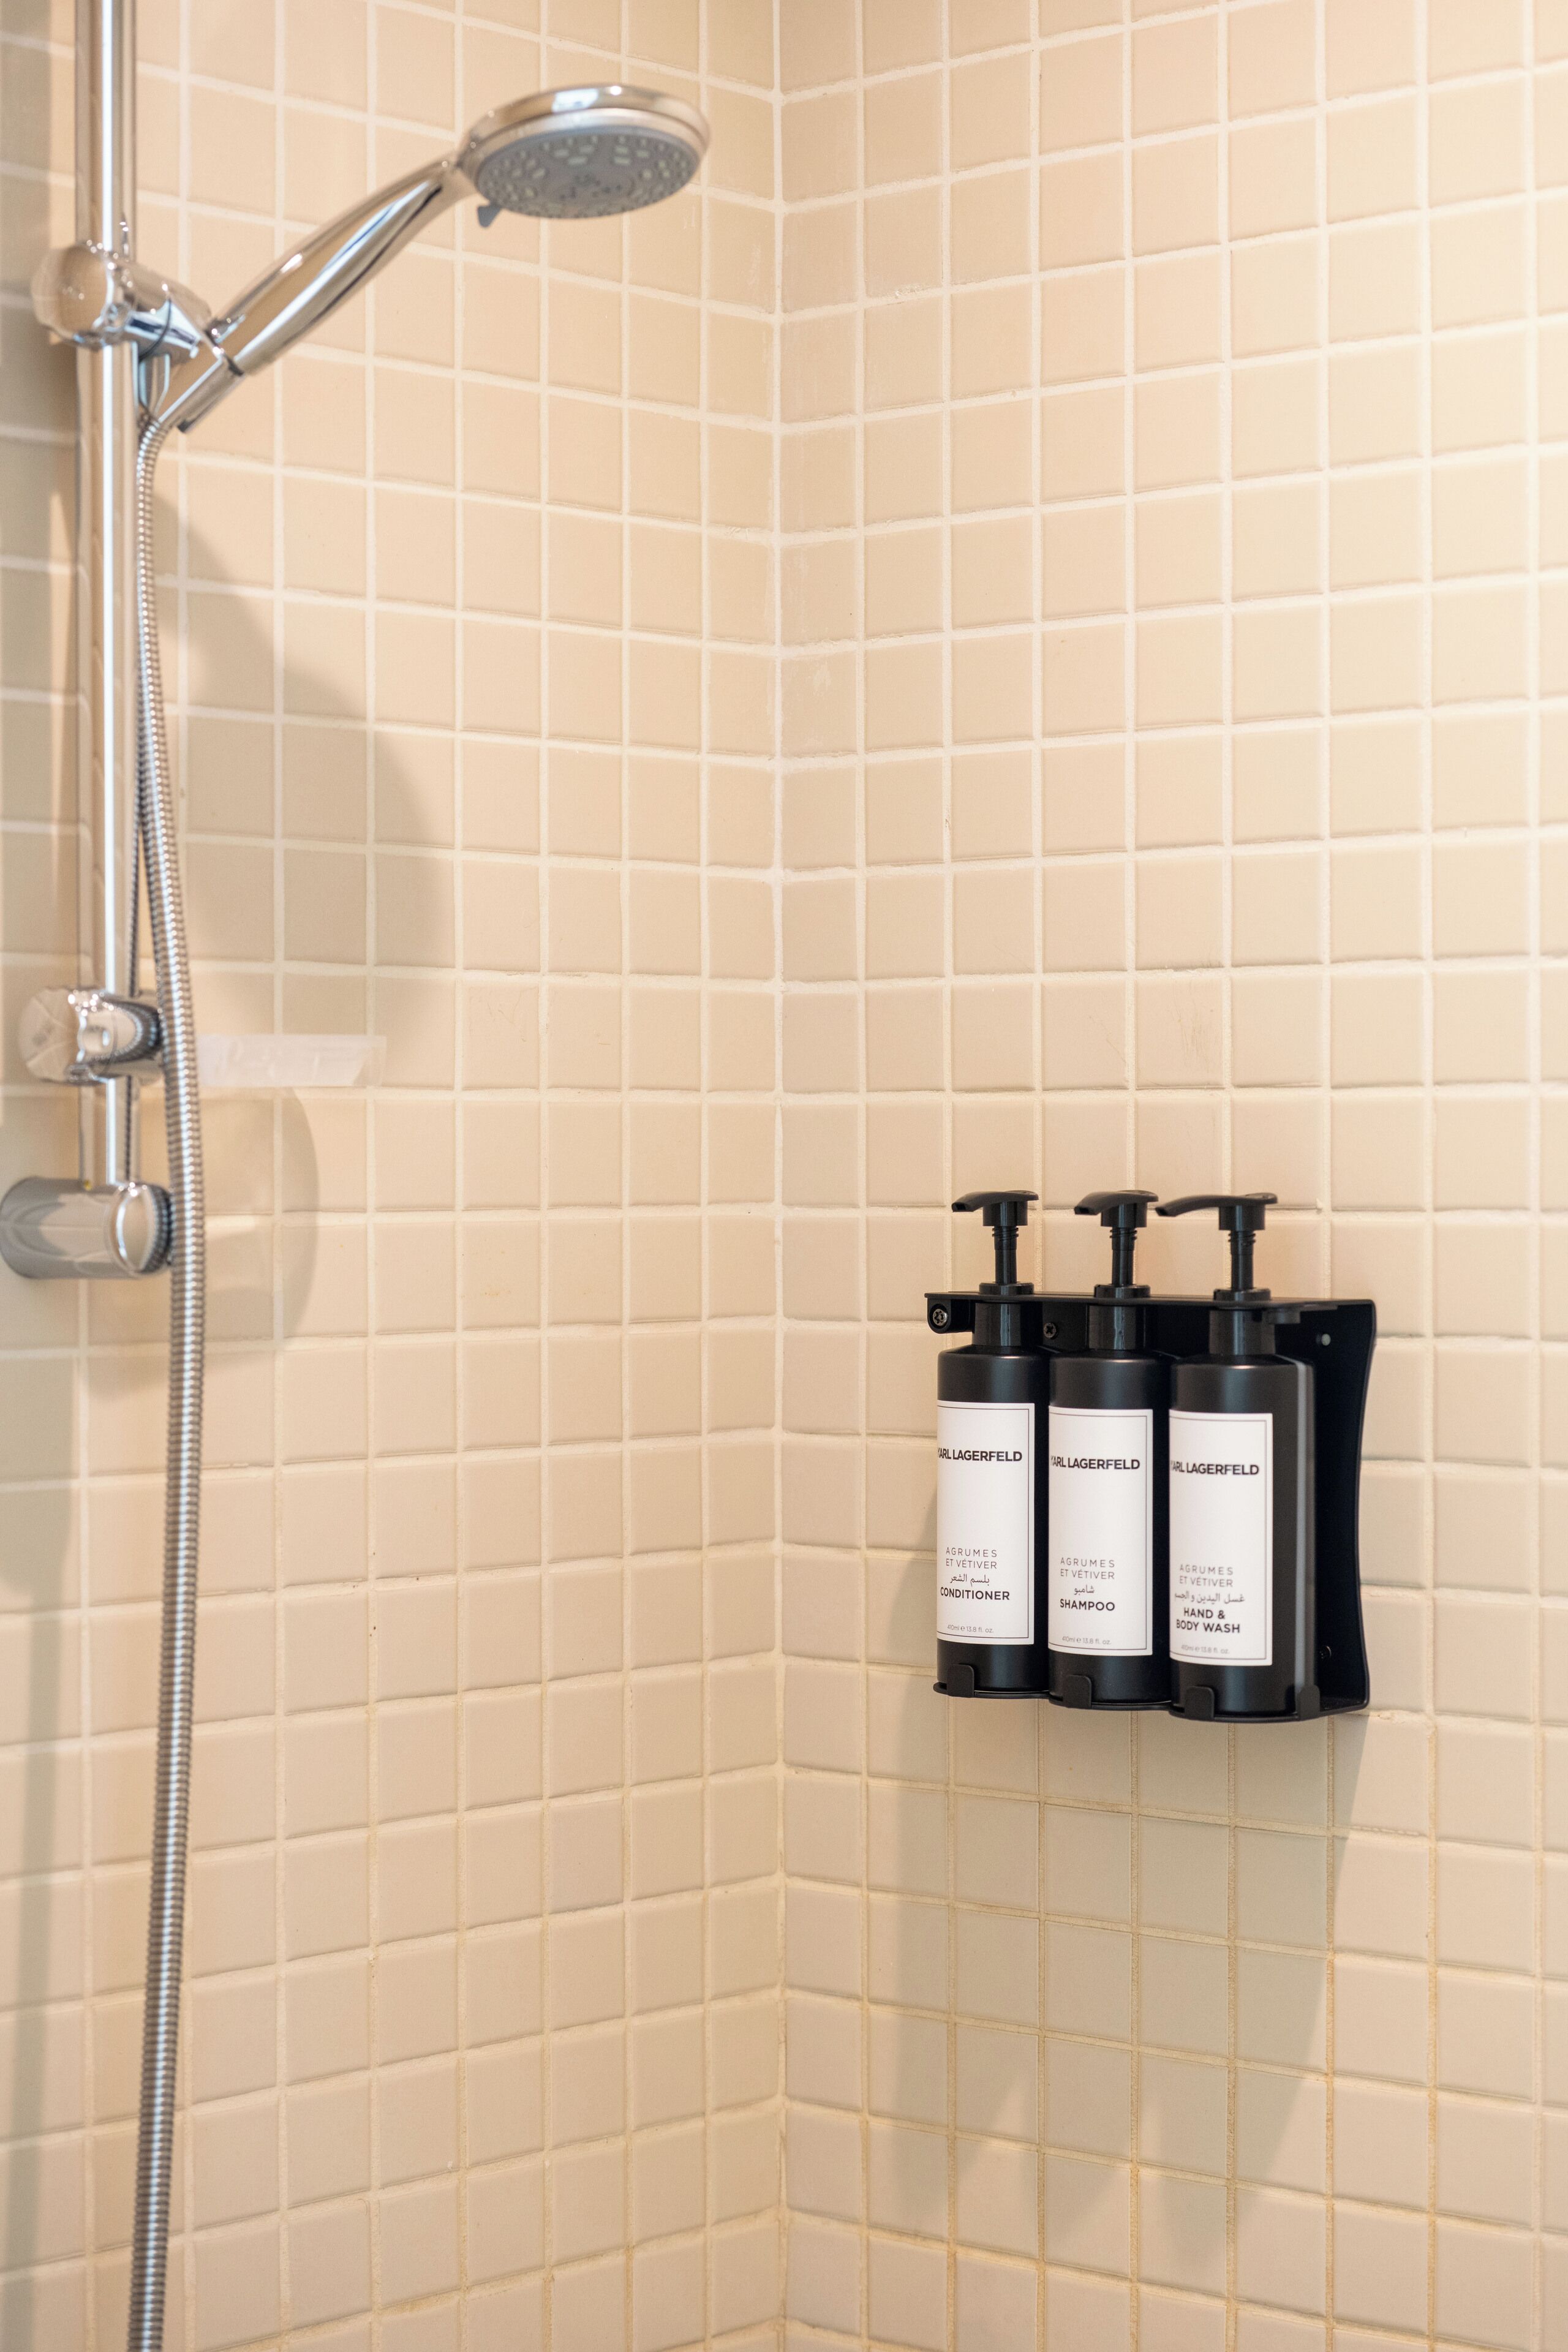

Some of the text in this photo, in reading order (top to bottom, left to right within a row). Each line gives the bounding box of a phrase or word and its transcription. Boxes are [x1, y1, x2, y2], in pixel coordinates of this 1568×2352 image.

[952, 1449, 1022, 1461] LAGERFELD
[1068, 1457, 1140, 1470] LAGERFELD
[1186, 1462, 1259, 1475] LAGERFELD
[946, 1547, 997, 1558] AGRUMES
[946, 1558, 997, 1569] ET VÉTIVER
[1060, 1557, 1115, 1568] AGRUMES
[1060, 1569, 1115, 1580] ET VÉTIVER
[1180, 1564, 1234, 1575] AGRUMES
[949, 1574, 990, 1587] بلسم الشعر
[1180, 1575, 1234, 1587] ET VÉTIVER
[940, 1586, 1010, 1600] CONDITIONER
[1074, 1585, 1095, 1596] شامبو
[1060, 1598, 1115, 1611] SHAMPOO
[1224, 1593, 1245, 1604] غسل
[1184, 1607, 1226, 1619] HAND &
[1176, 1619, 1240, 1634] BODY WASH
